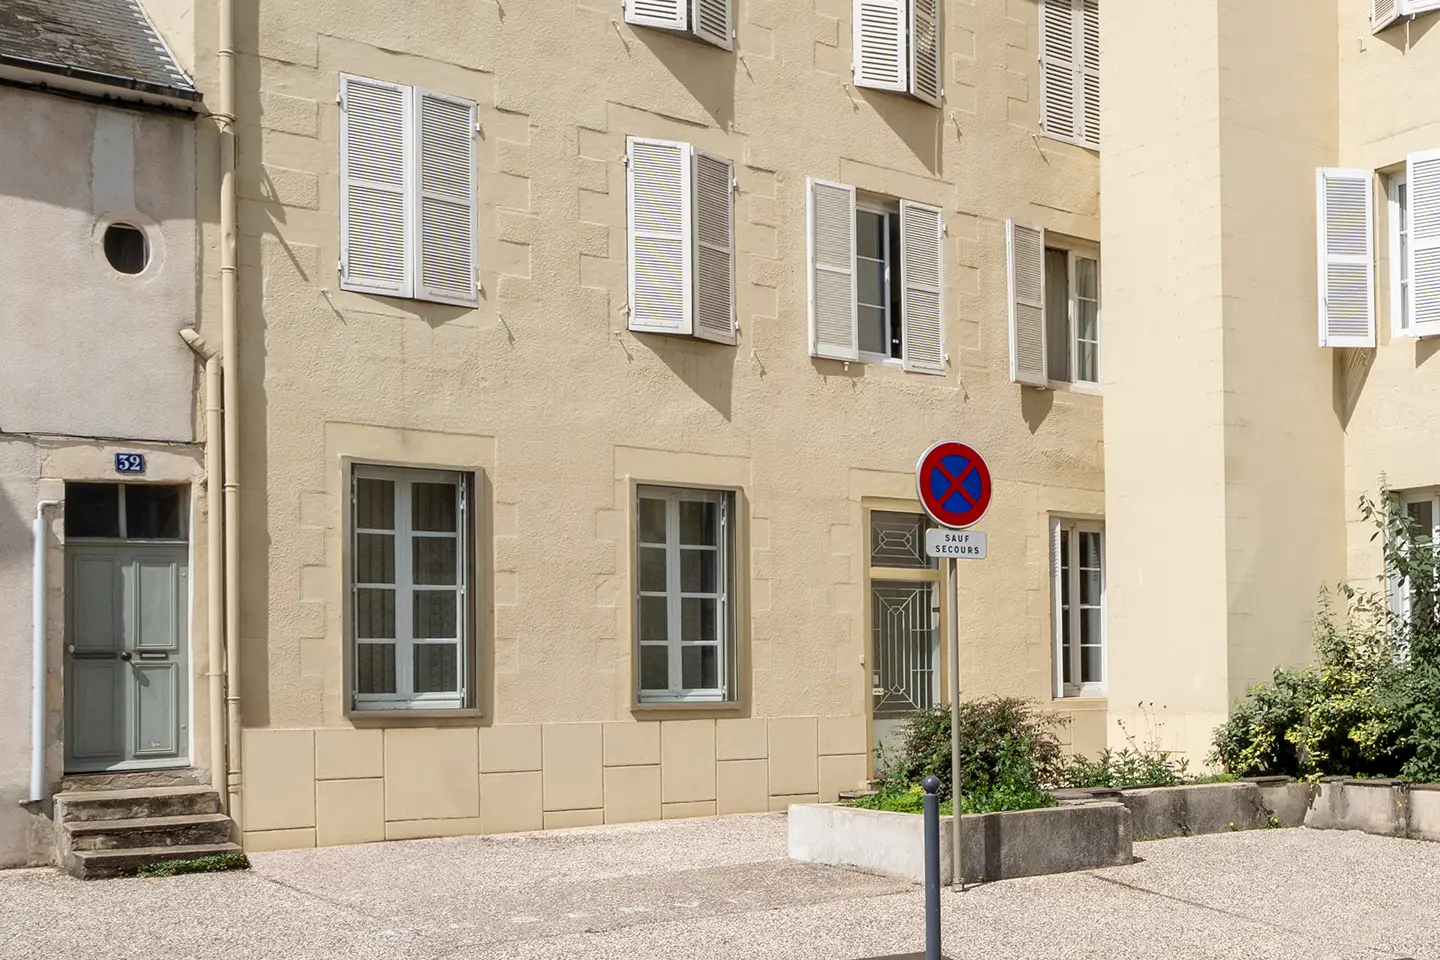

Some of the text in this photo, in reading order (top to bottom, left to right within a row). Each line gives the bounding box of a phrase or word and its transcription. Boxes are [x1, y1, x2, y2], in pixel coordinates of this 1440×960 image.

[118, 455, 141, 471] 32
[945, 534, 970, 543] SAUF
[935, 545, 980, 555] SECOURS
